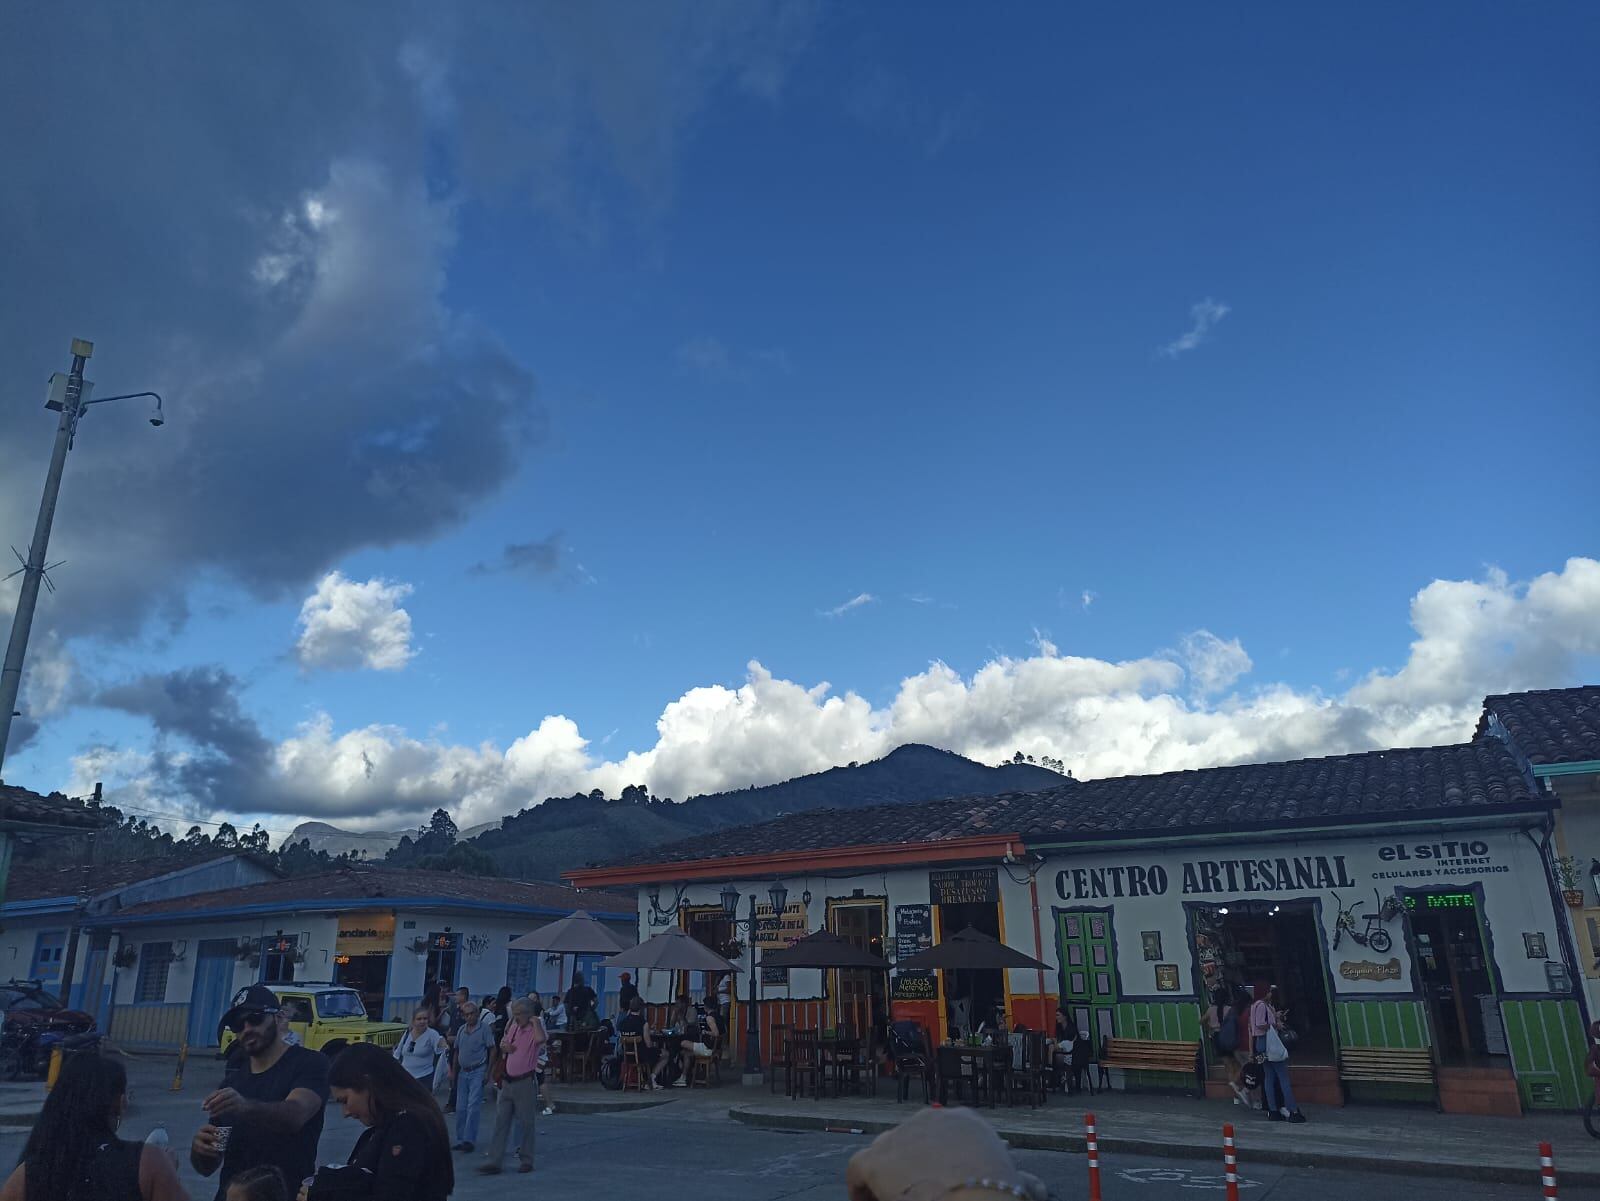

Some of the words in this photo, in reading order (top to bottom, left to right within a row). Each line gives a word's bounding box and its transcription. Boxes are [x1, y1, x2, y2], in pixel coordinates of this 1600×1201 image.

[1437, 857, 1491, 867] INTERNET
[1055, 865, 1168, 900] CENTRO
[1182, 856, 1356, 893] ARTESANAL
[1372, 869, 1433, 879] CELULARES
[1443, 866, 1510, 875] ACCESORIOS
